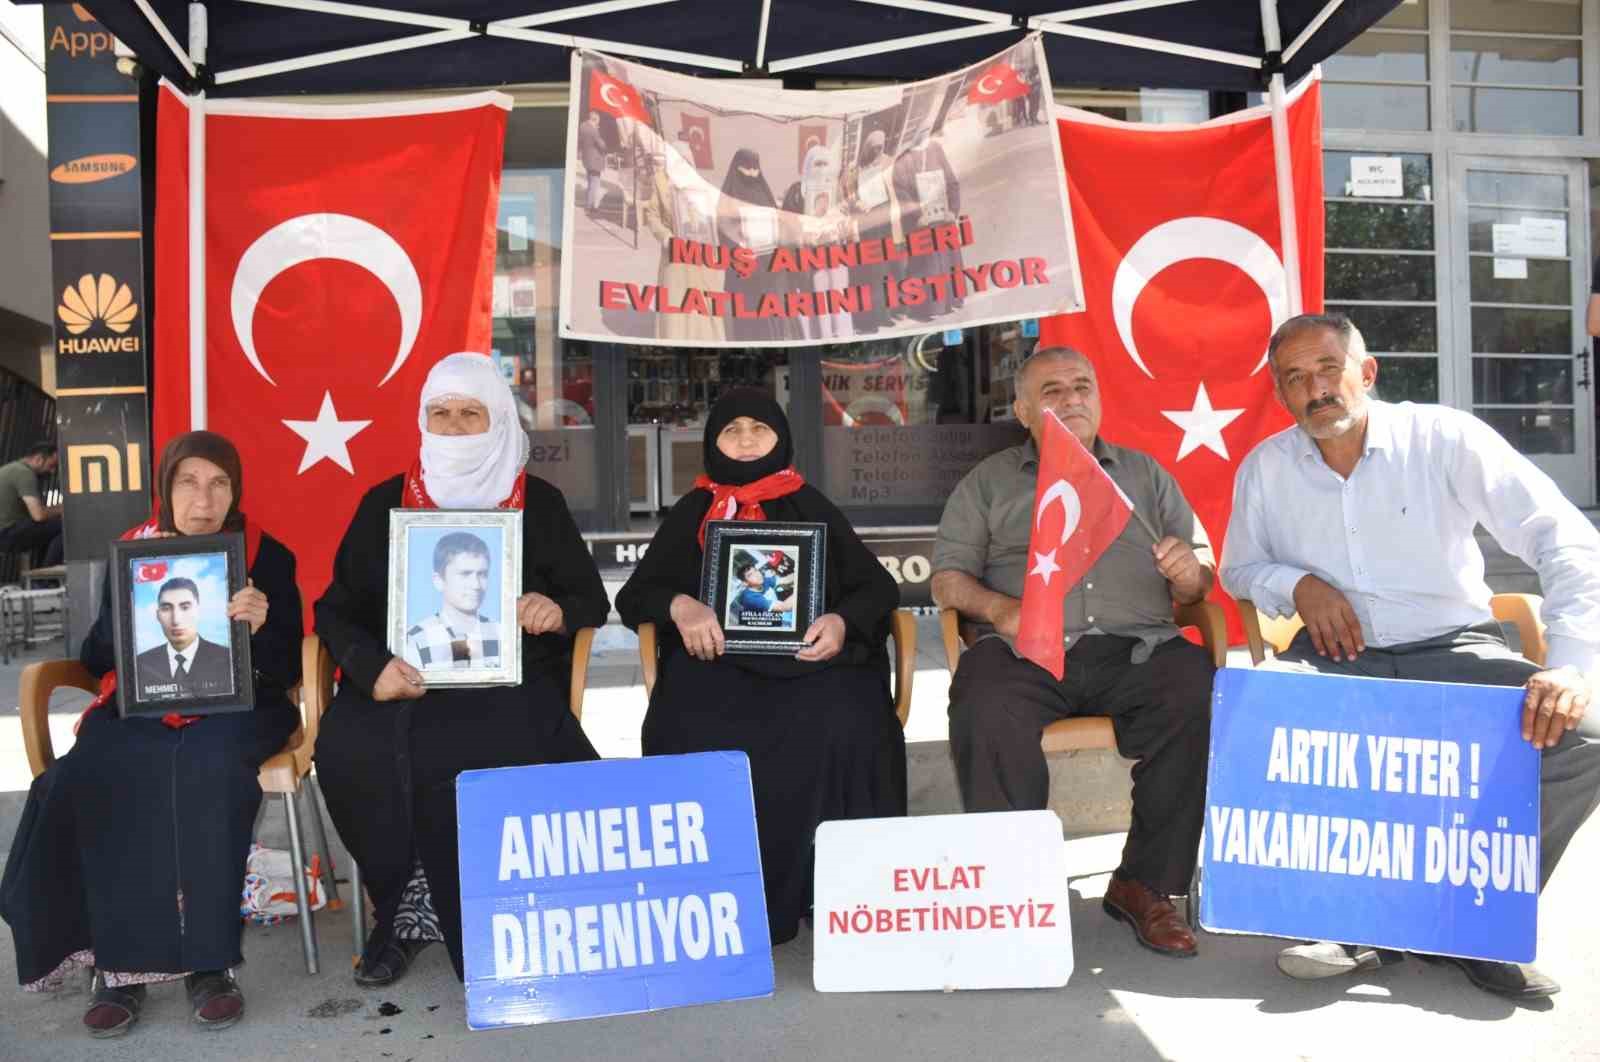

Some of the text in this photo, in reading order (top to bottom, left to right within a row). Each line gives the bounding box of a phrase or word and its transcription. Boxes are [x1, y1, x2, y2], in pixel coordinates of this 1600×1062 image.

[63, 160, 127, 174] SAMSUNG
[669, 214, 976, 280] MUŞ ANNELERİ
[599, 256, 1050, 320] EVLATLARINI İSTİYOR
[58, 336, 140, 355] HUAWEI
[1266, 727, 1359, 789] ARTIK
[1367, 735, 1461, 797] YETER
[497, 801, 710, 881] ANNELER
[1210, 805, 1538, 906] YAKAMIZDAN DÜŞÜN
[893, 865, 986, 892] EVLAT
[491, 882, 745, 981] DİRENİYOR
[828, 898, 1057, 935] NÖBETİNDEYİZ
